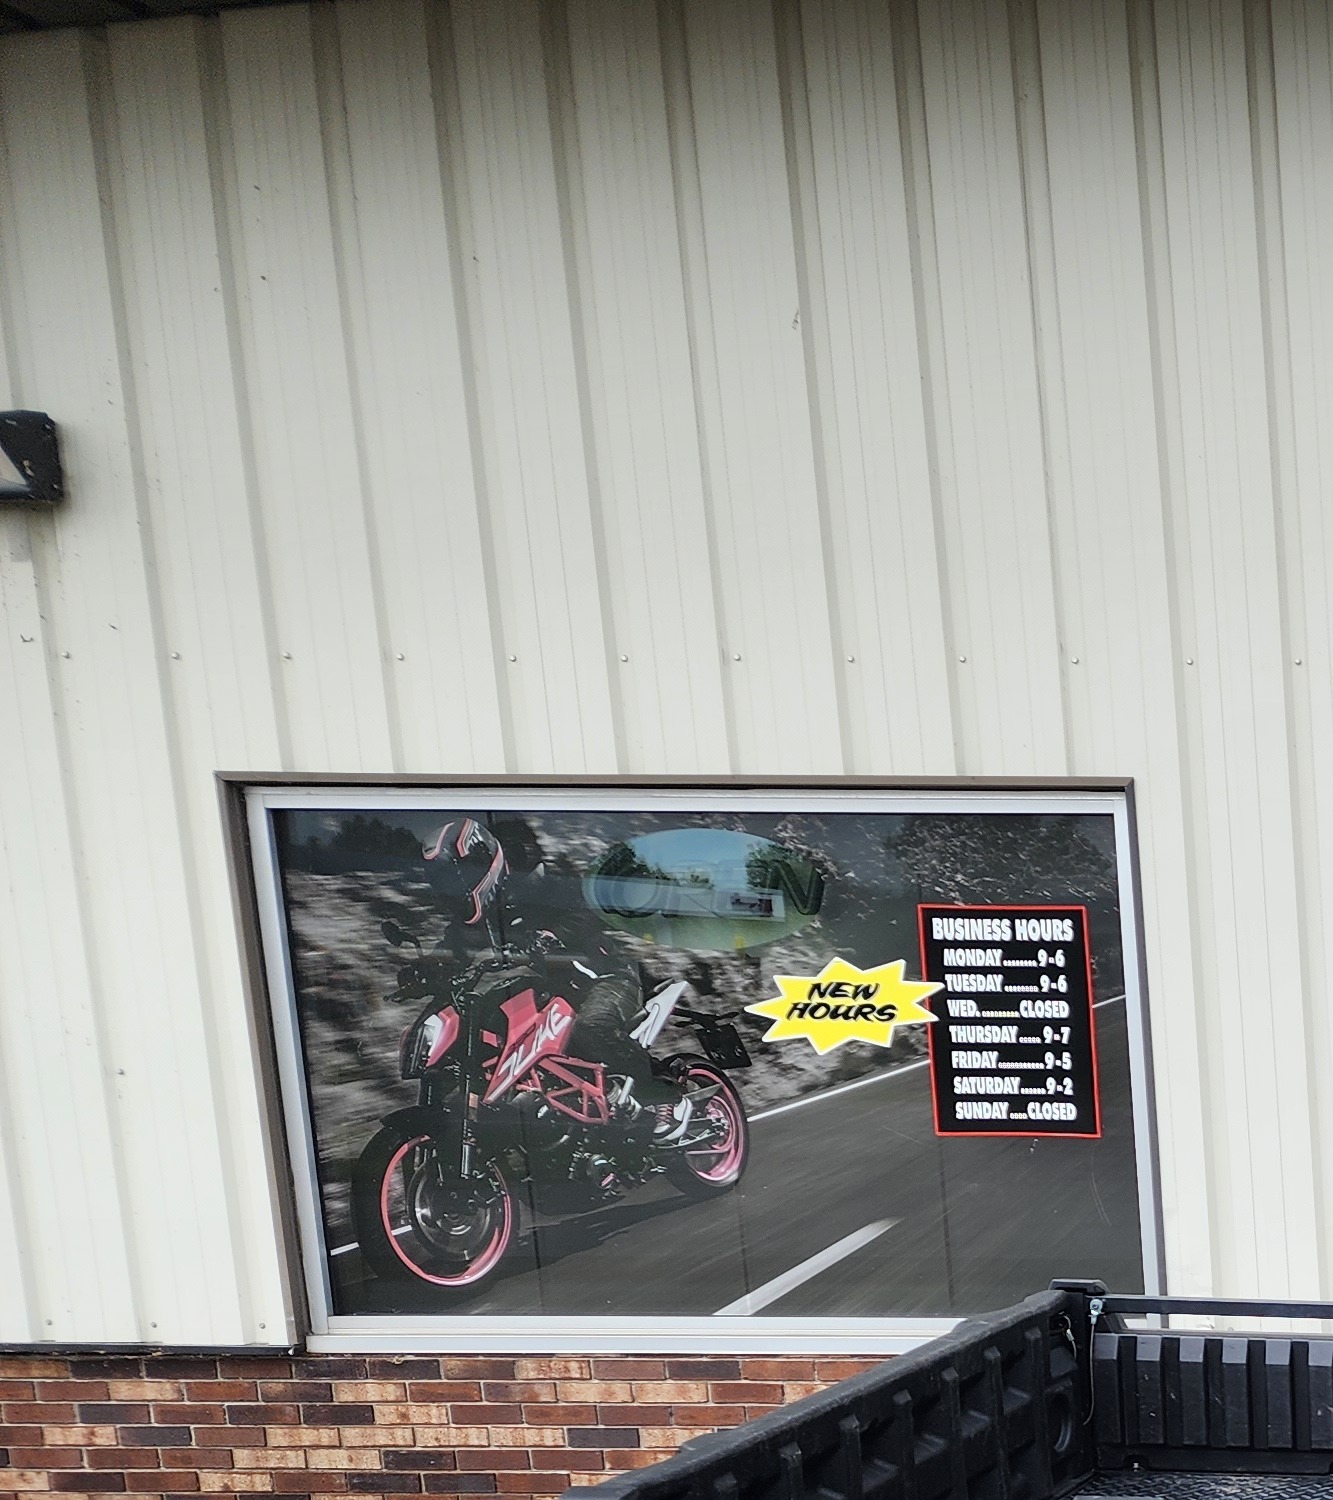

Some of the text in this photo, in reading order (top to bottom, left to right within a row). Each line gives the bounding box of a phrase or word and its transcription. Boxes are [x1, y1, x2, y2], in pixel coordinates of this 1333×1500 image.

[932, 917, 1074, 942] BUSINESS HOURS
[943, 948, 1003, 967] MONDAY
[808, 982, 881, 1001] NEW
[945, 974, 1004, 992] TUESDAY
[785, 1002, 899, 1022] HOURS
[1019, 1000, 1070, 1018] CLOSED
[949, 1025, 1019, 1044] THURSDAY
[951, 1051, 999, 1069] FRIDAY
[953, 1076, 1021, 1095] SATURDAY
[955, 1102, 1078, 1120] SUNDAY CLOSED
